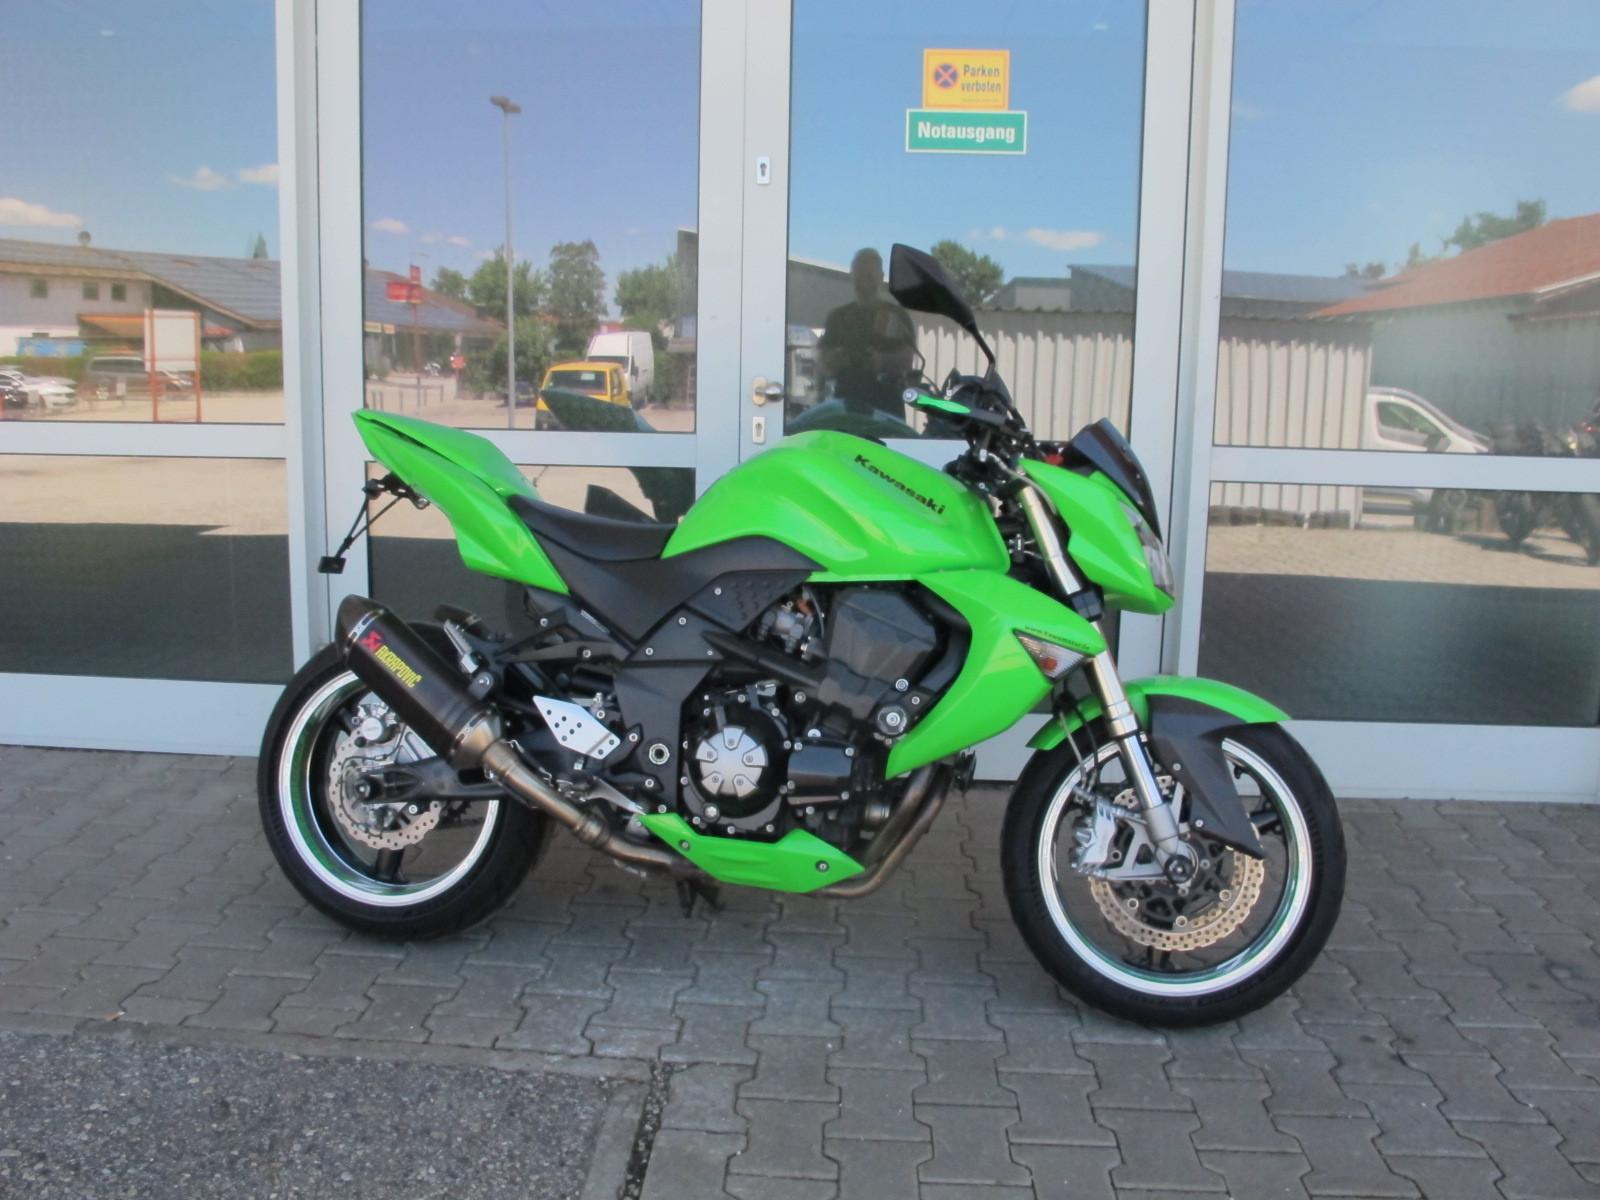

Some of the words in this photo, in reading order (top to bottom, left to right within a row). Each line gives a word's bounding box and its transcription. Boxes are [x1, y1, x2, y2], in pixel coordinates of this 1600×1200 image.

[963, 64, 1000, 78] Parken
[961, 80, 1001, 93] verboten
[917, 121, 1016, 144] Notausgang
[854, 454, 946, 515] Kawasaki
